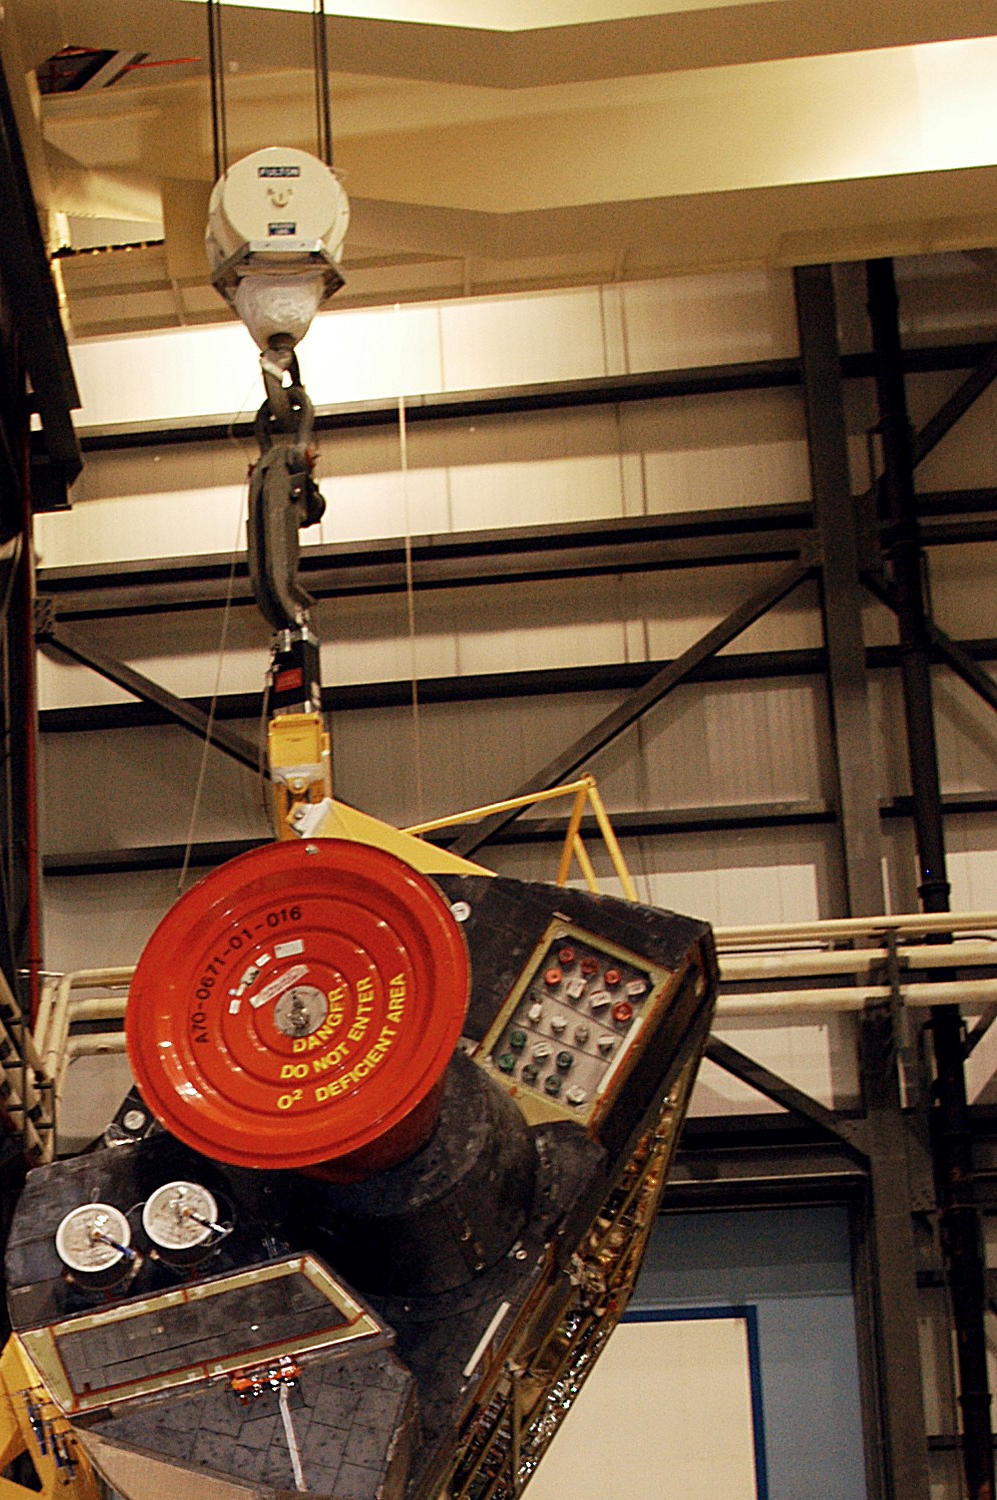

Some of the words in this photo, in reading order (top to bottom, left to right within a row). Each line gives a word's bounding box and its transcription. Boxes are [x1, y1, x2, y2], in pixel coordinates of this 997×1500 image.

[191, 905, 302, 1043] A70-0671-01-016
[280, 1063, 310, 1079] DO
[312, 1041, 350, 1073] NOT
[347, 976, 375, 1042] ENTER
[292, 986, 345, 1054] DANGER
[314, 1025, 398, 1102] DEFICIENT
[386, 972, 407, 1024] AREA
